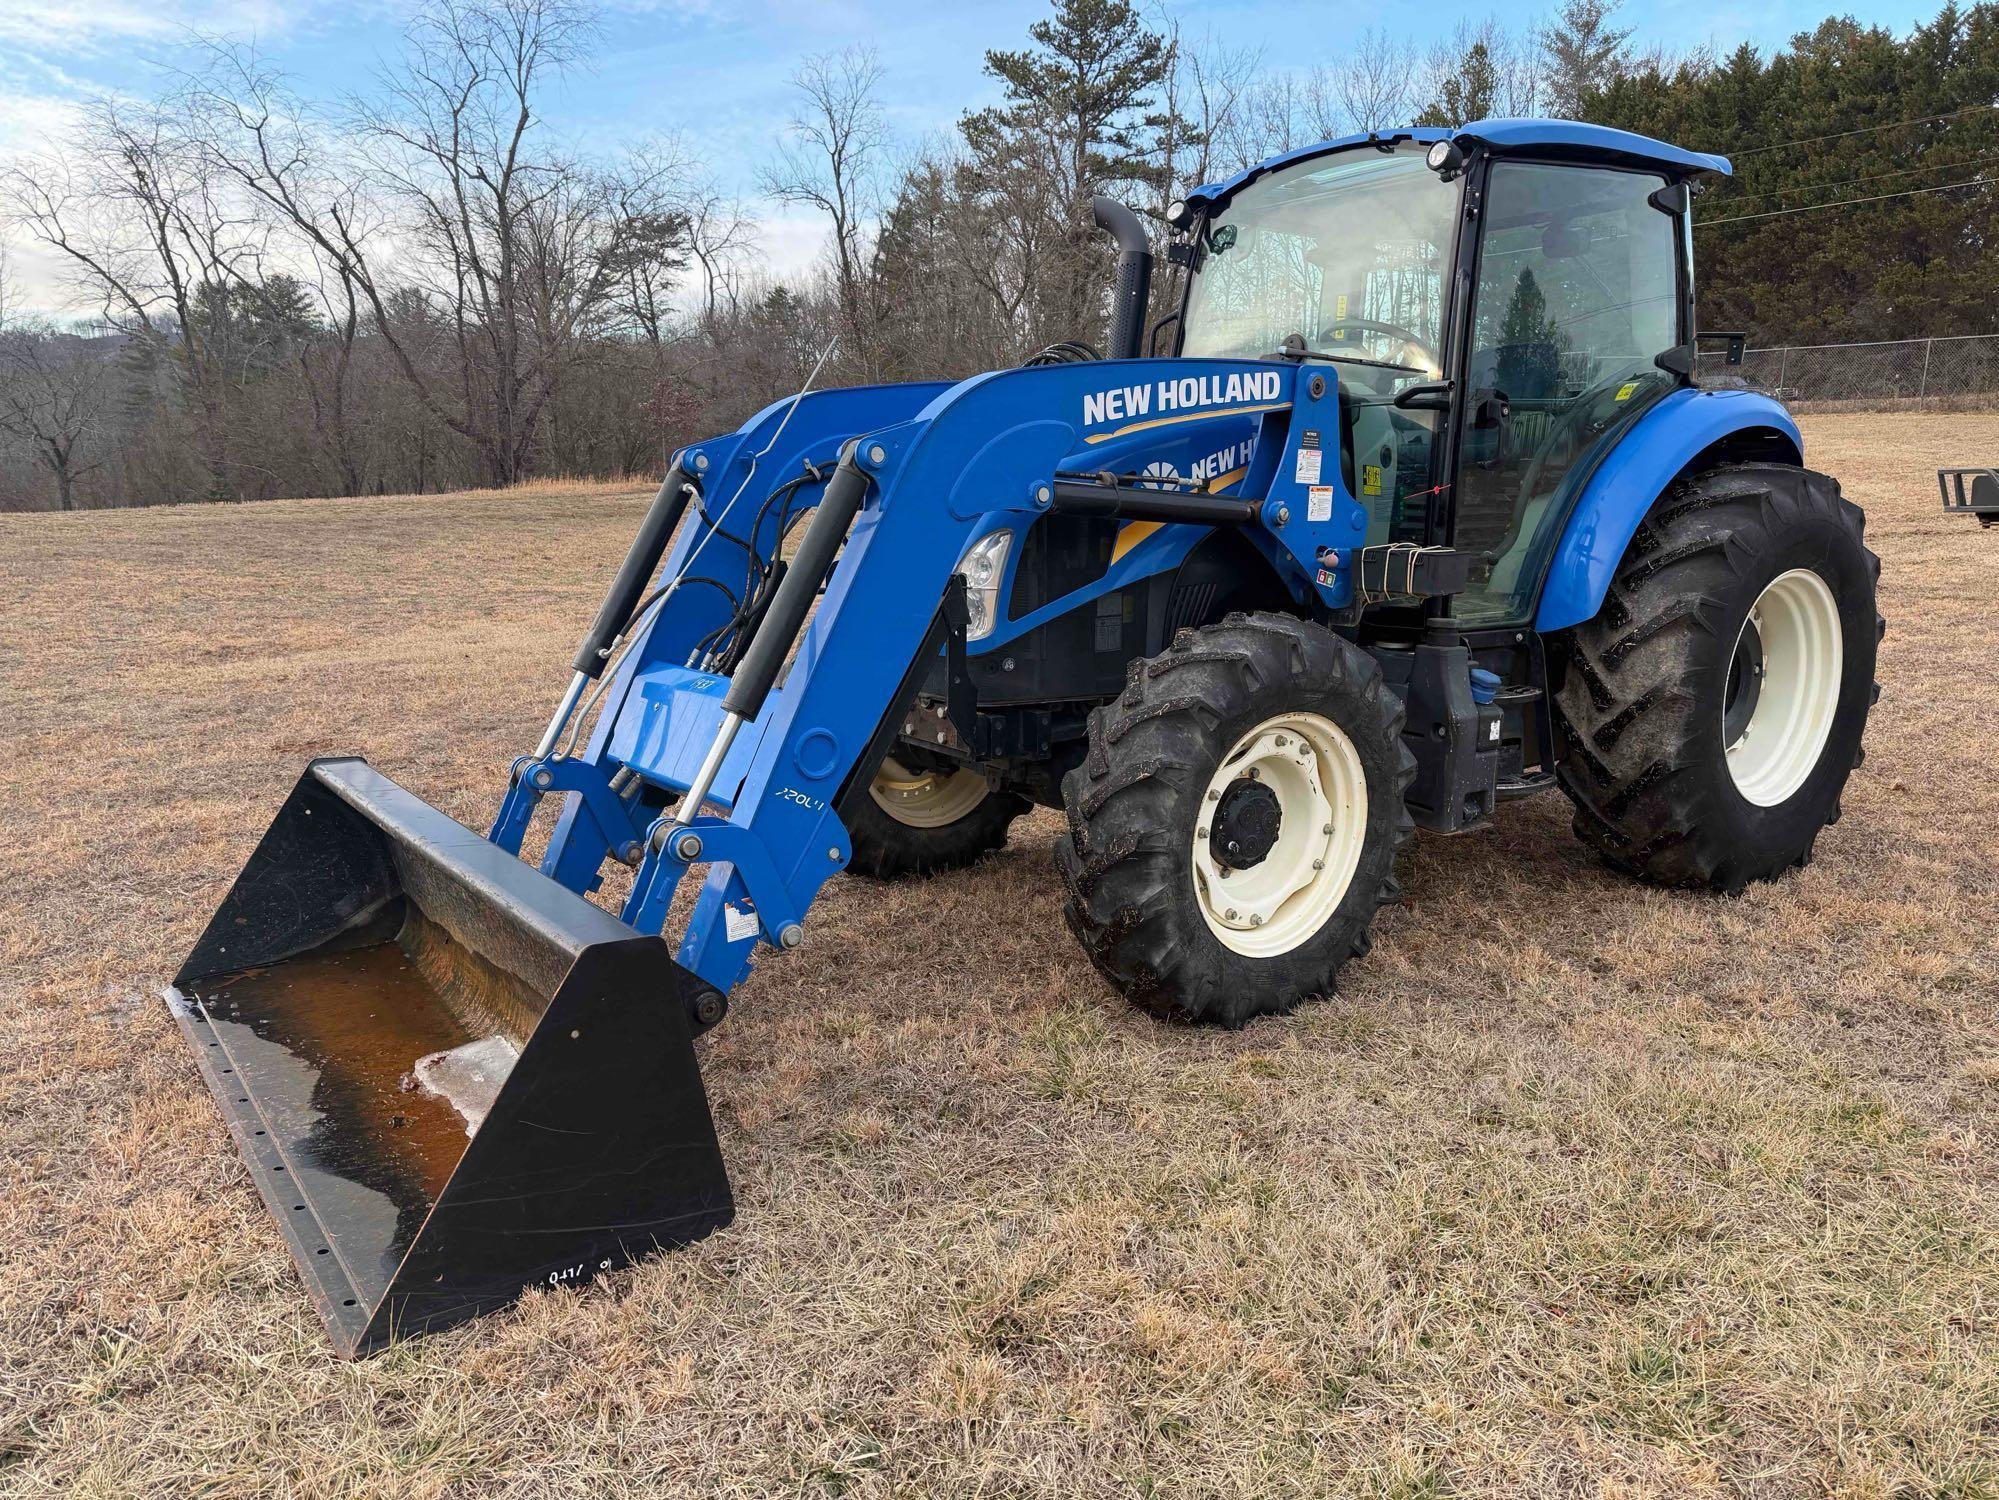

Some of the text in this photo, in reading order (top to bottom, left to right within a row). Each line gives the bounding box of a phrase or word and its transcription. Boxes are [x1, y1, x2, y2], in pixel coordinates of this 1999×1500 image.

[1083, 371, 1281, 426] NEW HOLLAND
[1191, 437, 1259, 480] NEW H
